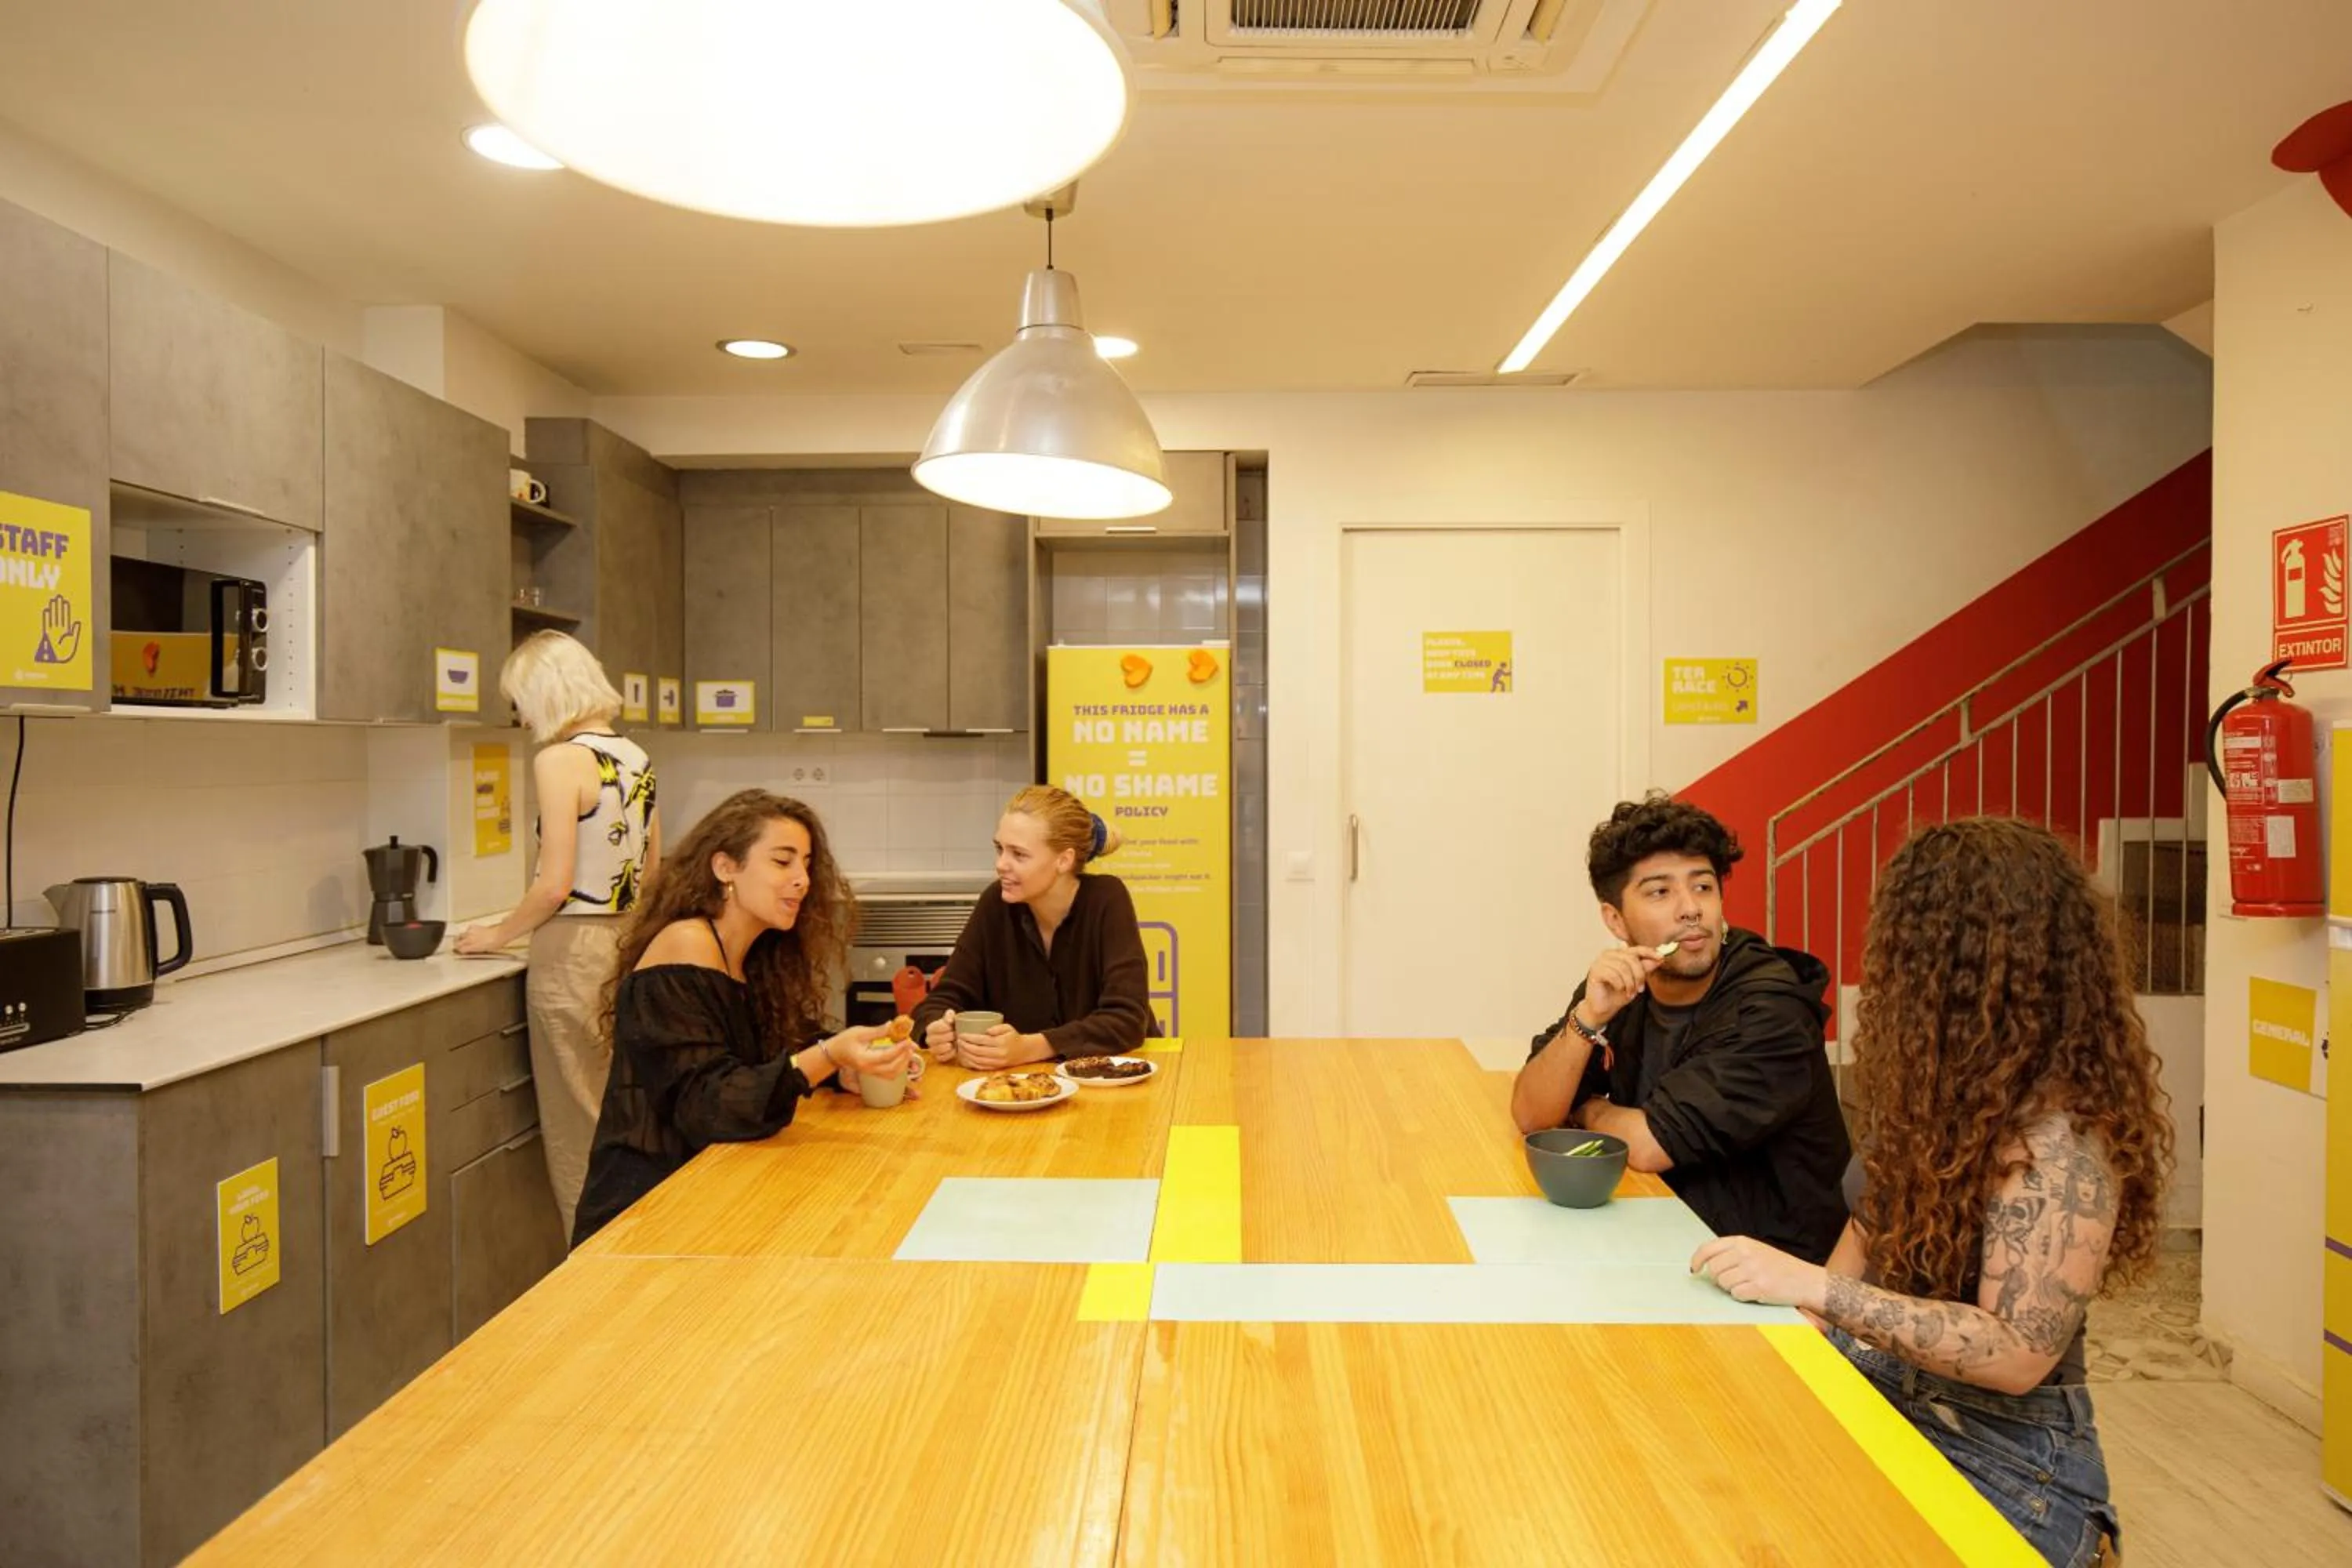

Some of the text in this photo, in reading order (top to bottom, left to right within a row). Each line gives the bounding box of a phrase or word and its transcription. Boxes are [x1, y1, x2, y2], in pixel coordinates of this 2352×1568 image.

[0, 523, 69, 559] TAFF
[2279, 637, 2342, 659] EXTINTOR
[1454, 659, 1491, 668] CLOSED
[1672, 666, 1705, 680] TER
[1671, 680, 1717, 694] RACE
[1073, 705, 1209, 716] THIS FRIDGE HAS A
[1073, 720, 1209, 744] NO NAME
[1065, 773, 1218, 798] NO SHAME
[1115, 805, 1168, 817] POLICY
[2252, 1018, 2310, 1047] GENERAL
[372, 1099, 399, 1122] GUEST
